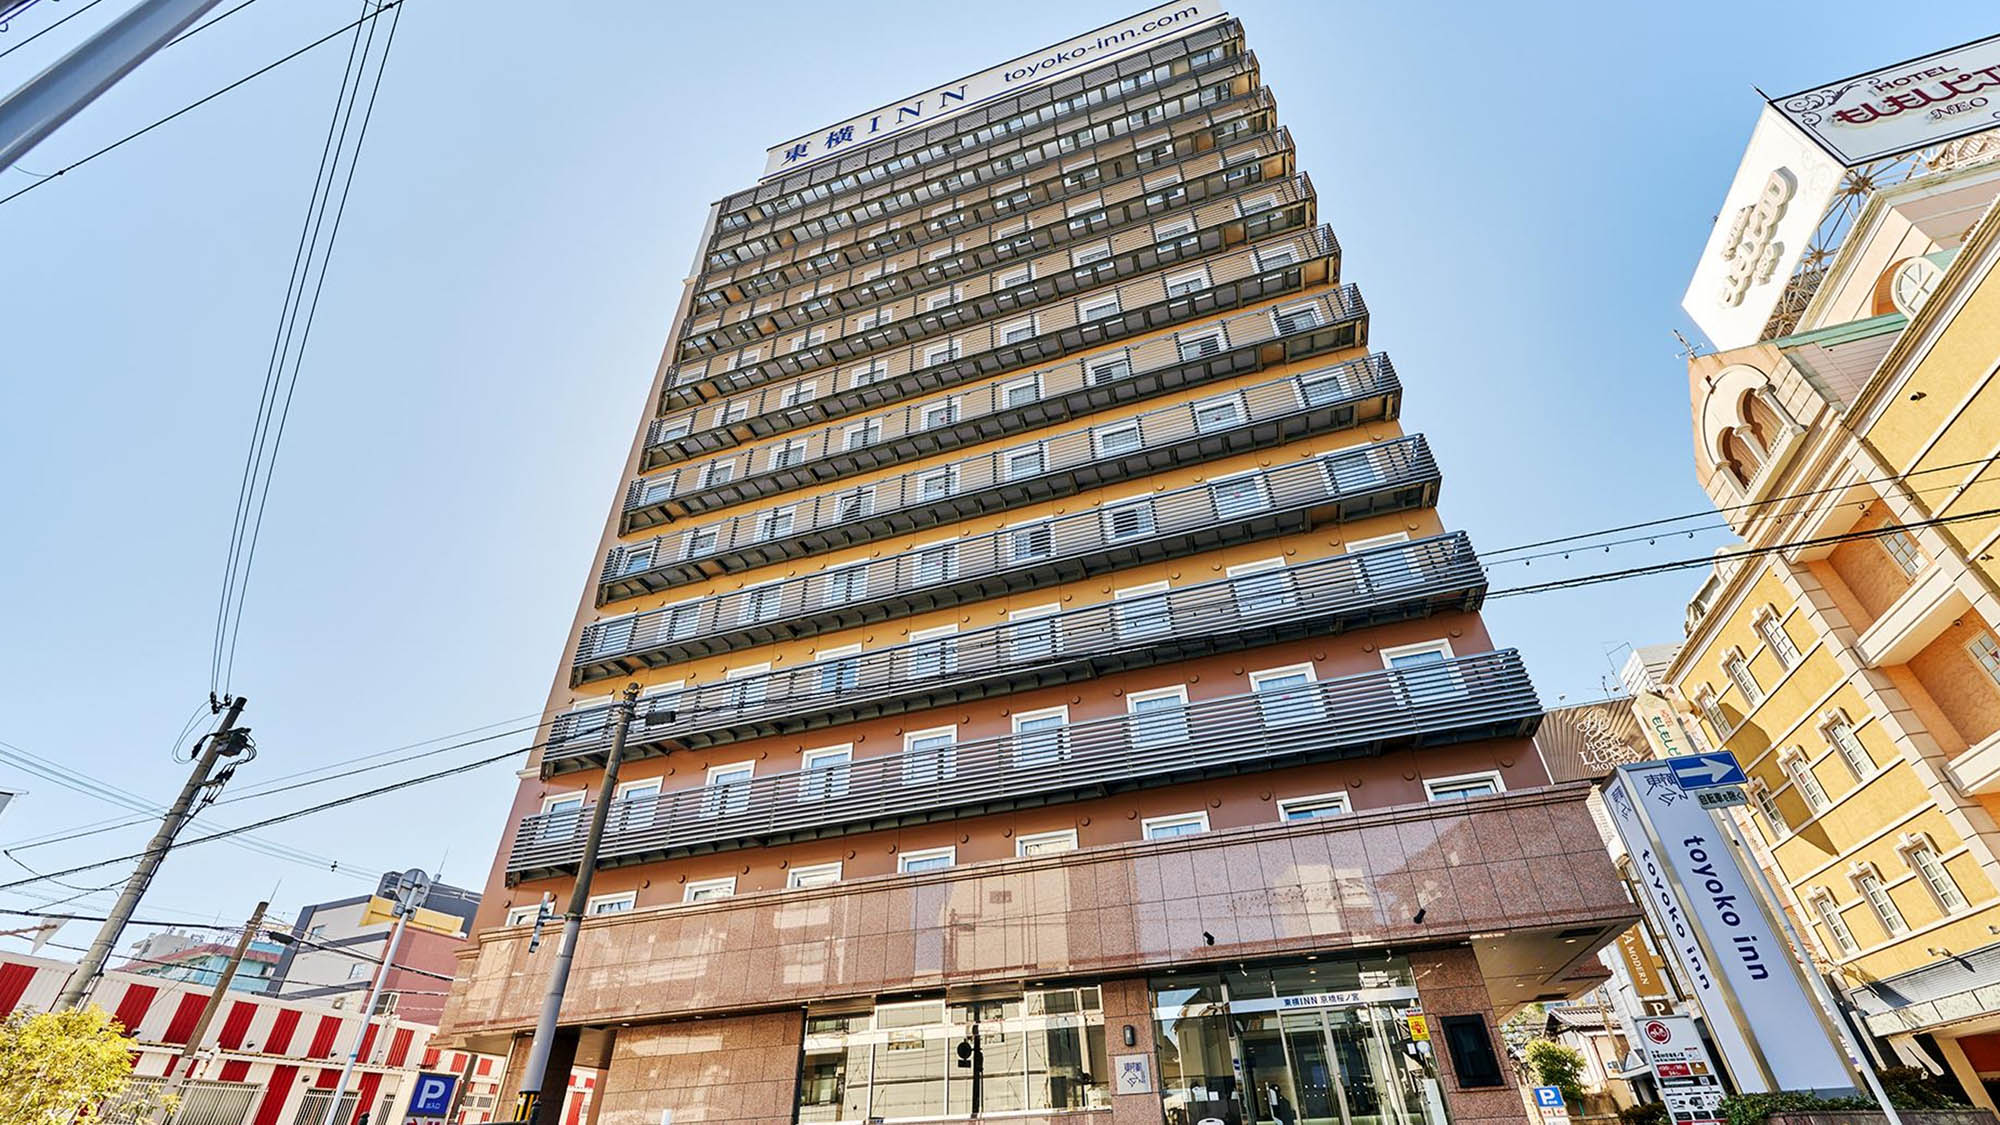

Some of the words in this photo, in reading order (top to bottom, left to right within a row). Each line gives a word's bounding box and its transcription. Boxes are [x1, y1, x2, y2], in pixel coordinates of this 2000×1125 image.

[1003, 3, 1199, 83] toyoko-inn.com
[1873, 65, 1960, 92] HOTEL
[1929, 96, 1989, 120] NEO
[1578, 745, 1643, 766] LUNA
[1642, 849, 1685, 939] toyoko
[1686, 946, 1710, 990] inn
[1683, 835, 1741, 927] toyoko
[1732, 935, 1769, 980] inn
[1626, 946, 1650, 985] MODERN
[1651, 1003, 1666, 1016] P
[417, 1080, 446, 1109] P
[1538, 1089, 1556, 1105] P
